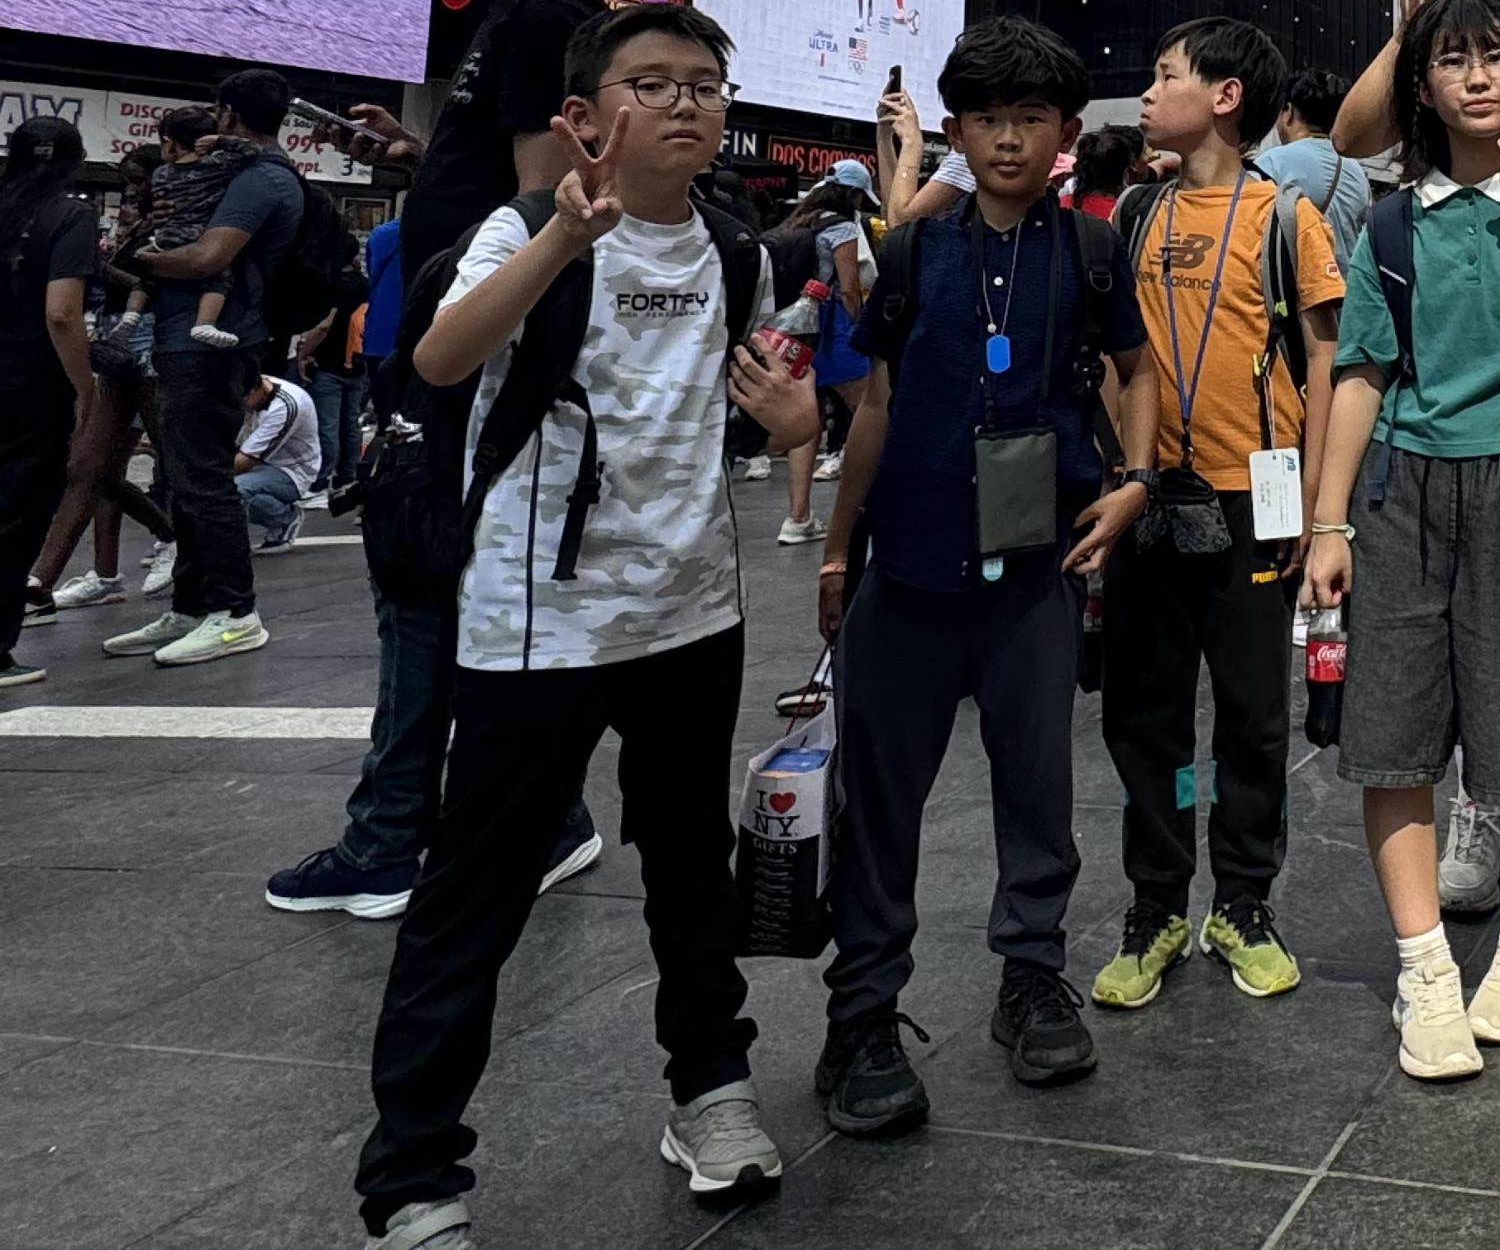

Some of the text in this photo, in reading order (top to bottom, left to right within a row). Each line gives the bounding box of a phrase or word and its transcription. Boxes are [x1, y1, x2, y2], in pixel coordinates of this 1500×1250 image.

[808, 36, 839, 54] ULTRA
[756, 789, 768, 812] I
[752, 811, 800, 837] NY
[753, 838, 798, 855] GIFTS
